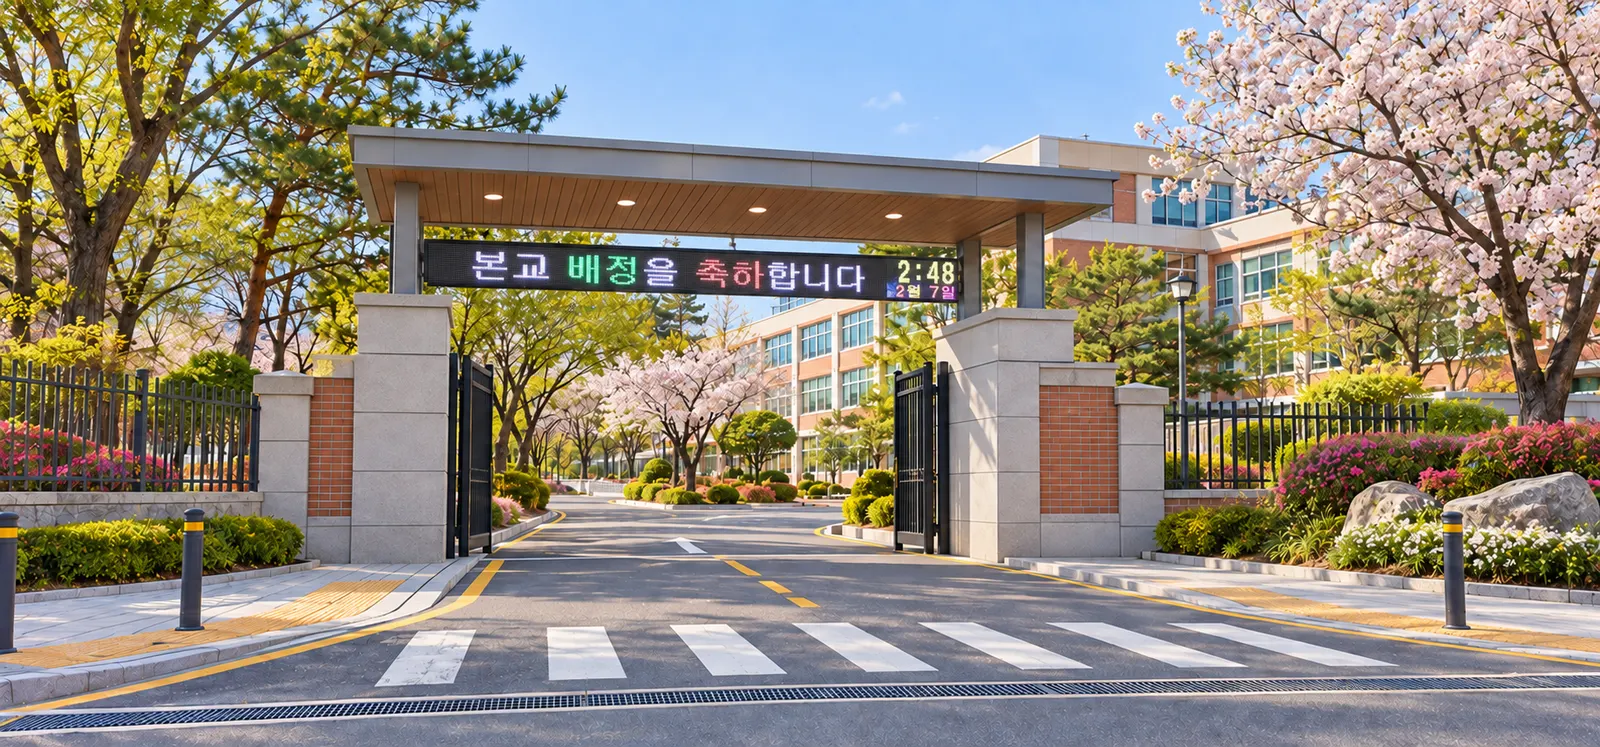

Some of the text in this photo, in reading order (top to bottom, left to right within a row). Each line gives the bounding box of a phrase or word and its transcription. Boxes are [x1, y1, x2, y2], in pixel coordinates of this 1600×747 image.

[472, 251, 865, 292] 본교 배정을 축하합니다
[898, 260, 955, 284] 2:48
[896, 285, 955, 299] 2월 7일
